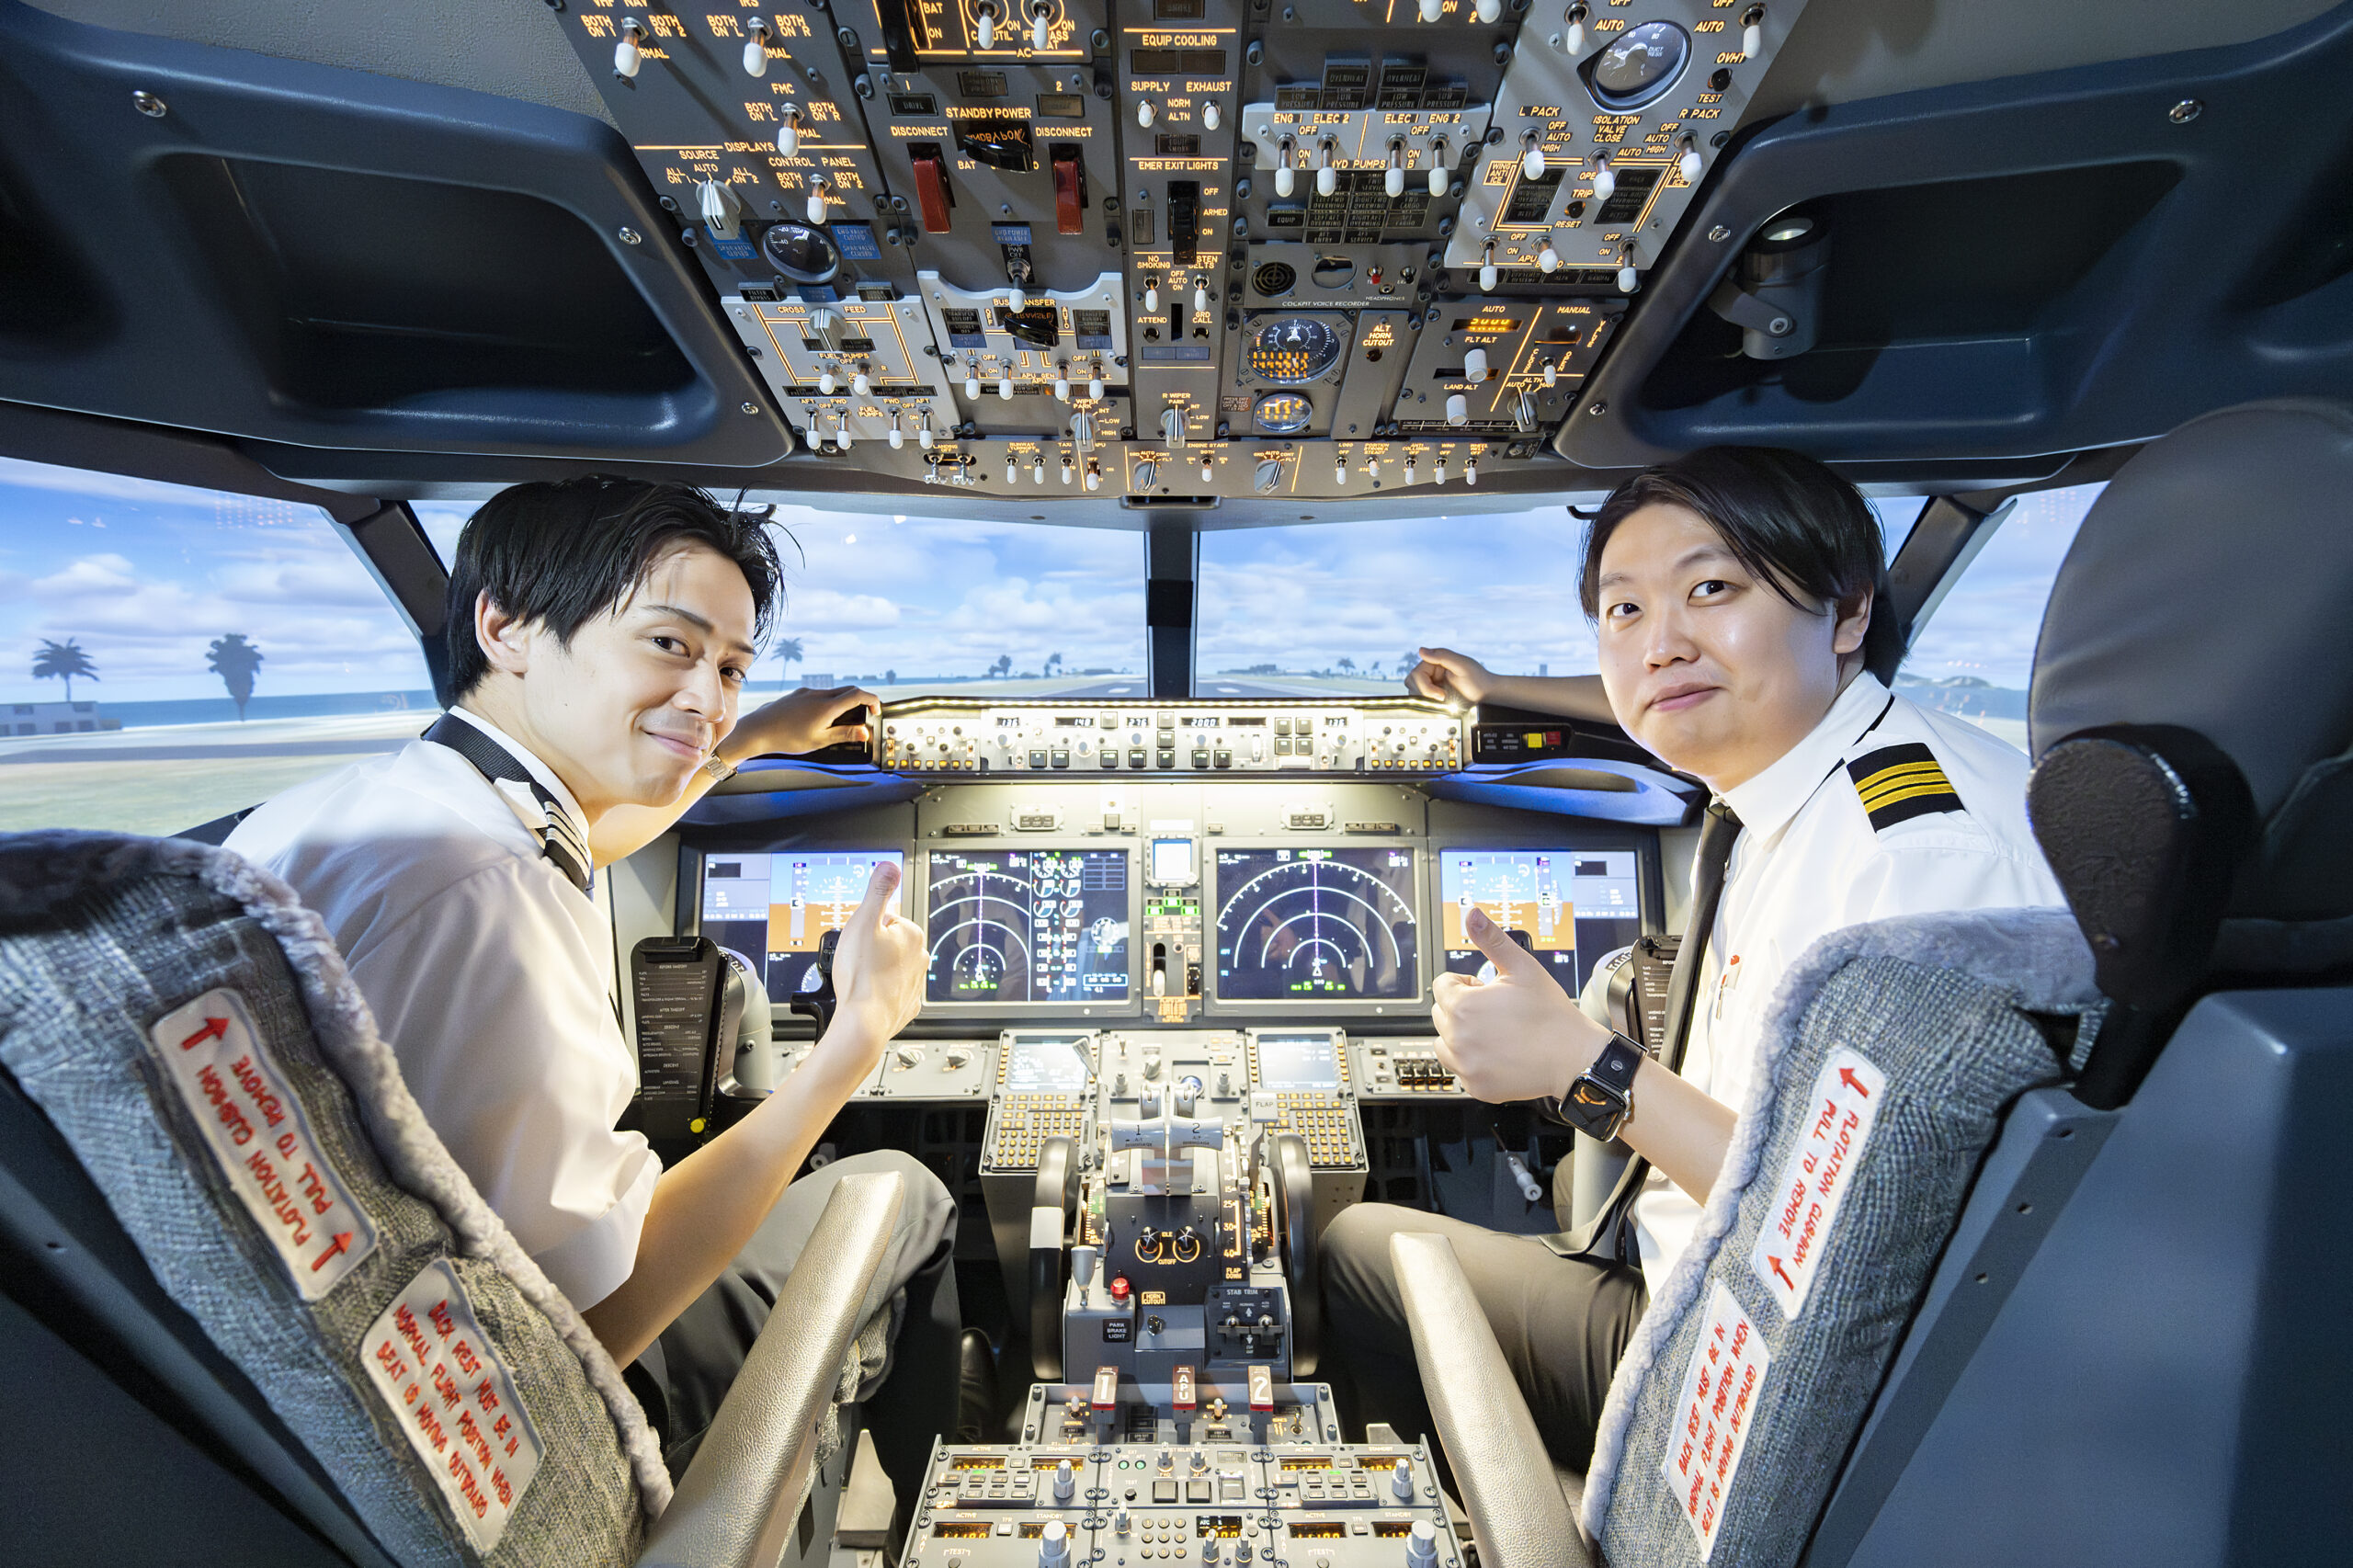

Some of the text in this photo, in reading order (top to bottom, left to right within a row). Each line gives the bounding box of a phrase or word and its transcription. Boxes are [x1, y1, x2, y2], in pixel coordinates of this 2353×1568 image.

[925, 2, 943, 14] BAT
[581, 15, 613, 27] BOTH
[648, 15, 680, 27] BOTH
[707, 15, 737, 27] BOTH
[775, 15, 805, 27] BOTH
[1594, 20, 1625, 31] AUTO
[1694, 21, 1725, 32] AUTO
[1142, 34, 1217, 47] EQUIP COOLING
[1017, 48, 1031, 58] AC
[1715, 52, 1745, 63] OVHT
[771, 83, 795, 94] FMC
[1131, 82, 1170, 92] SUPPLY
[1186, 82, 1232, 92] EXHAUST
[1167, 98, 1190, 108] NORM
[1698, 94, 1722, 103] TEST
[745, 102, 772, 113] BOTH
[808, 102, 836, 112] BOTH
[1530, 107, 1560, 117] PACK
[946, 108, 1031, 119] STANDBY POWER
[1168, 112, 1190, 121] ALTN
[1273, 114, 1293, 123] ENG
[1313, 114, 1340, 123] ELEC
[1384, 114, 1412, 123] ELEC
[1429, 114, 1450, 123] ENG
[1688, 108, 1722, 119] PACK
[1592, 116, 1640, 125] ISOLATION
[891, 126, 948, 137] DISCONNECT
[1036, 127, 1092, 138] DISCONNECT
[1598, 125, 1627, 134] VALVE
[1546, 132, 1572, 142] AUTO
[1593, 134, 1623, 142] CLOSE
[1644, 134, 1671, 142] AUTO
[724, 142, 775, 153] DISPLAYS
[1540, 143, 1562, 153] HIGH
[1618, 148, 1643, 156] AUTO
[1645, 145, 1667, 153] HIGH
[679, 151, 720, 160] SOURCE
[768, 157, 856, 166] CONTROL PANEL
[958, 161, 976, 170] BAT
[1139, 162, 1218, 170] EMER EXIT LIGHTS
[1352, 160, 1386, 169] PUMPS
[694, 164, 719, 173] AUTO
[1572, 189, 1594, 199] TRIP
[844, 305, 866, 313] FEED
[1482, 305, 1506, 313] AUTO
[1373, 324, 1391, 333] ALT
[1136, 1124, 1142, 1136] 1
[1192, 1123, 1200, 1134] 2
[230, 1055, 334, 1215] PULL TO REMOVE
[196, 1064, 313, 1247] FLOTATION CUSHION
[1779, 1098, 1837, 1240] PULL TO REMOVE
[1793, 1110, 1859, 1269] FLOTATION CUSHION
[1223, 1200, 1234, 1209] 25
[1223, 1249, 1234, 1257] 40
[1101, 1375, 1109, 1401] 1
[1253, 1376, 1268, 1401] 2
